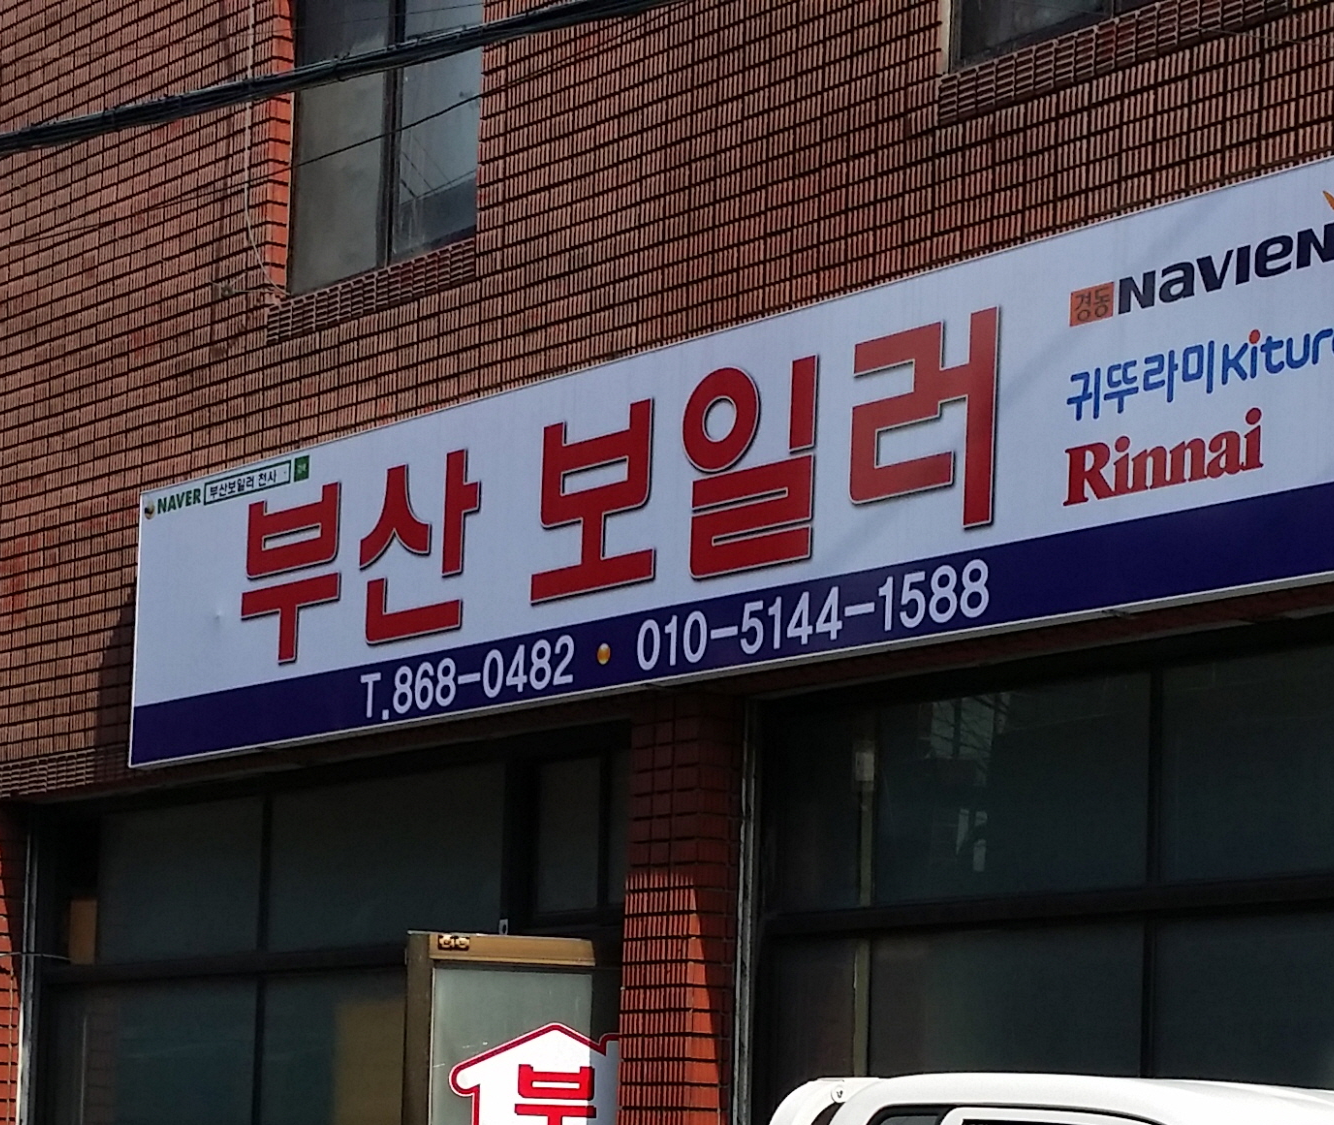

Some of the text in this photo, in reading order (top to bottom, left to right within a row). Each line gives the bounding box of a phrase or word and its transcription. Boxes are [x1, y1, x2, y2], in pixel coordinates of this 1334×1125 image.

[1073, 286, 1110, 322] 경동
[1067, 339, 1215, 421] 귀뚜라미
[157, 488, 201, 514] NAVER
[209, 476, 255, 499] 부산보일러
[240, 305, 1001, 664] 부산 보일러
[1063, 407, 1263, 506] Rinnai
[360, 558, 990, 720] T.868-0482 010-5144-1588
